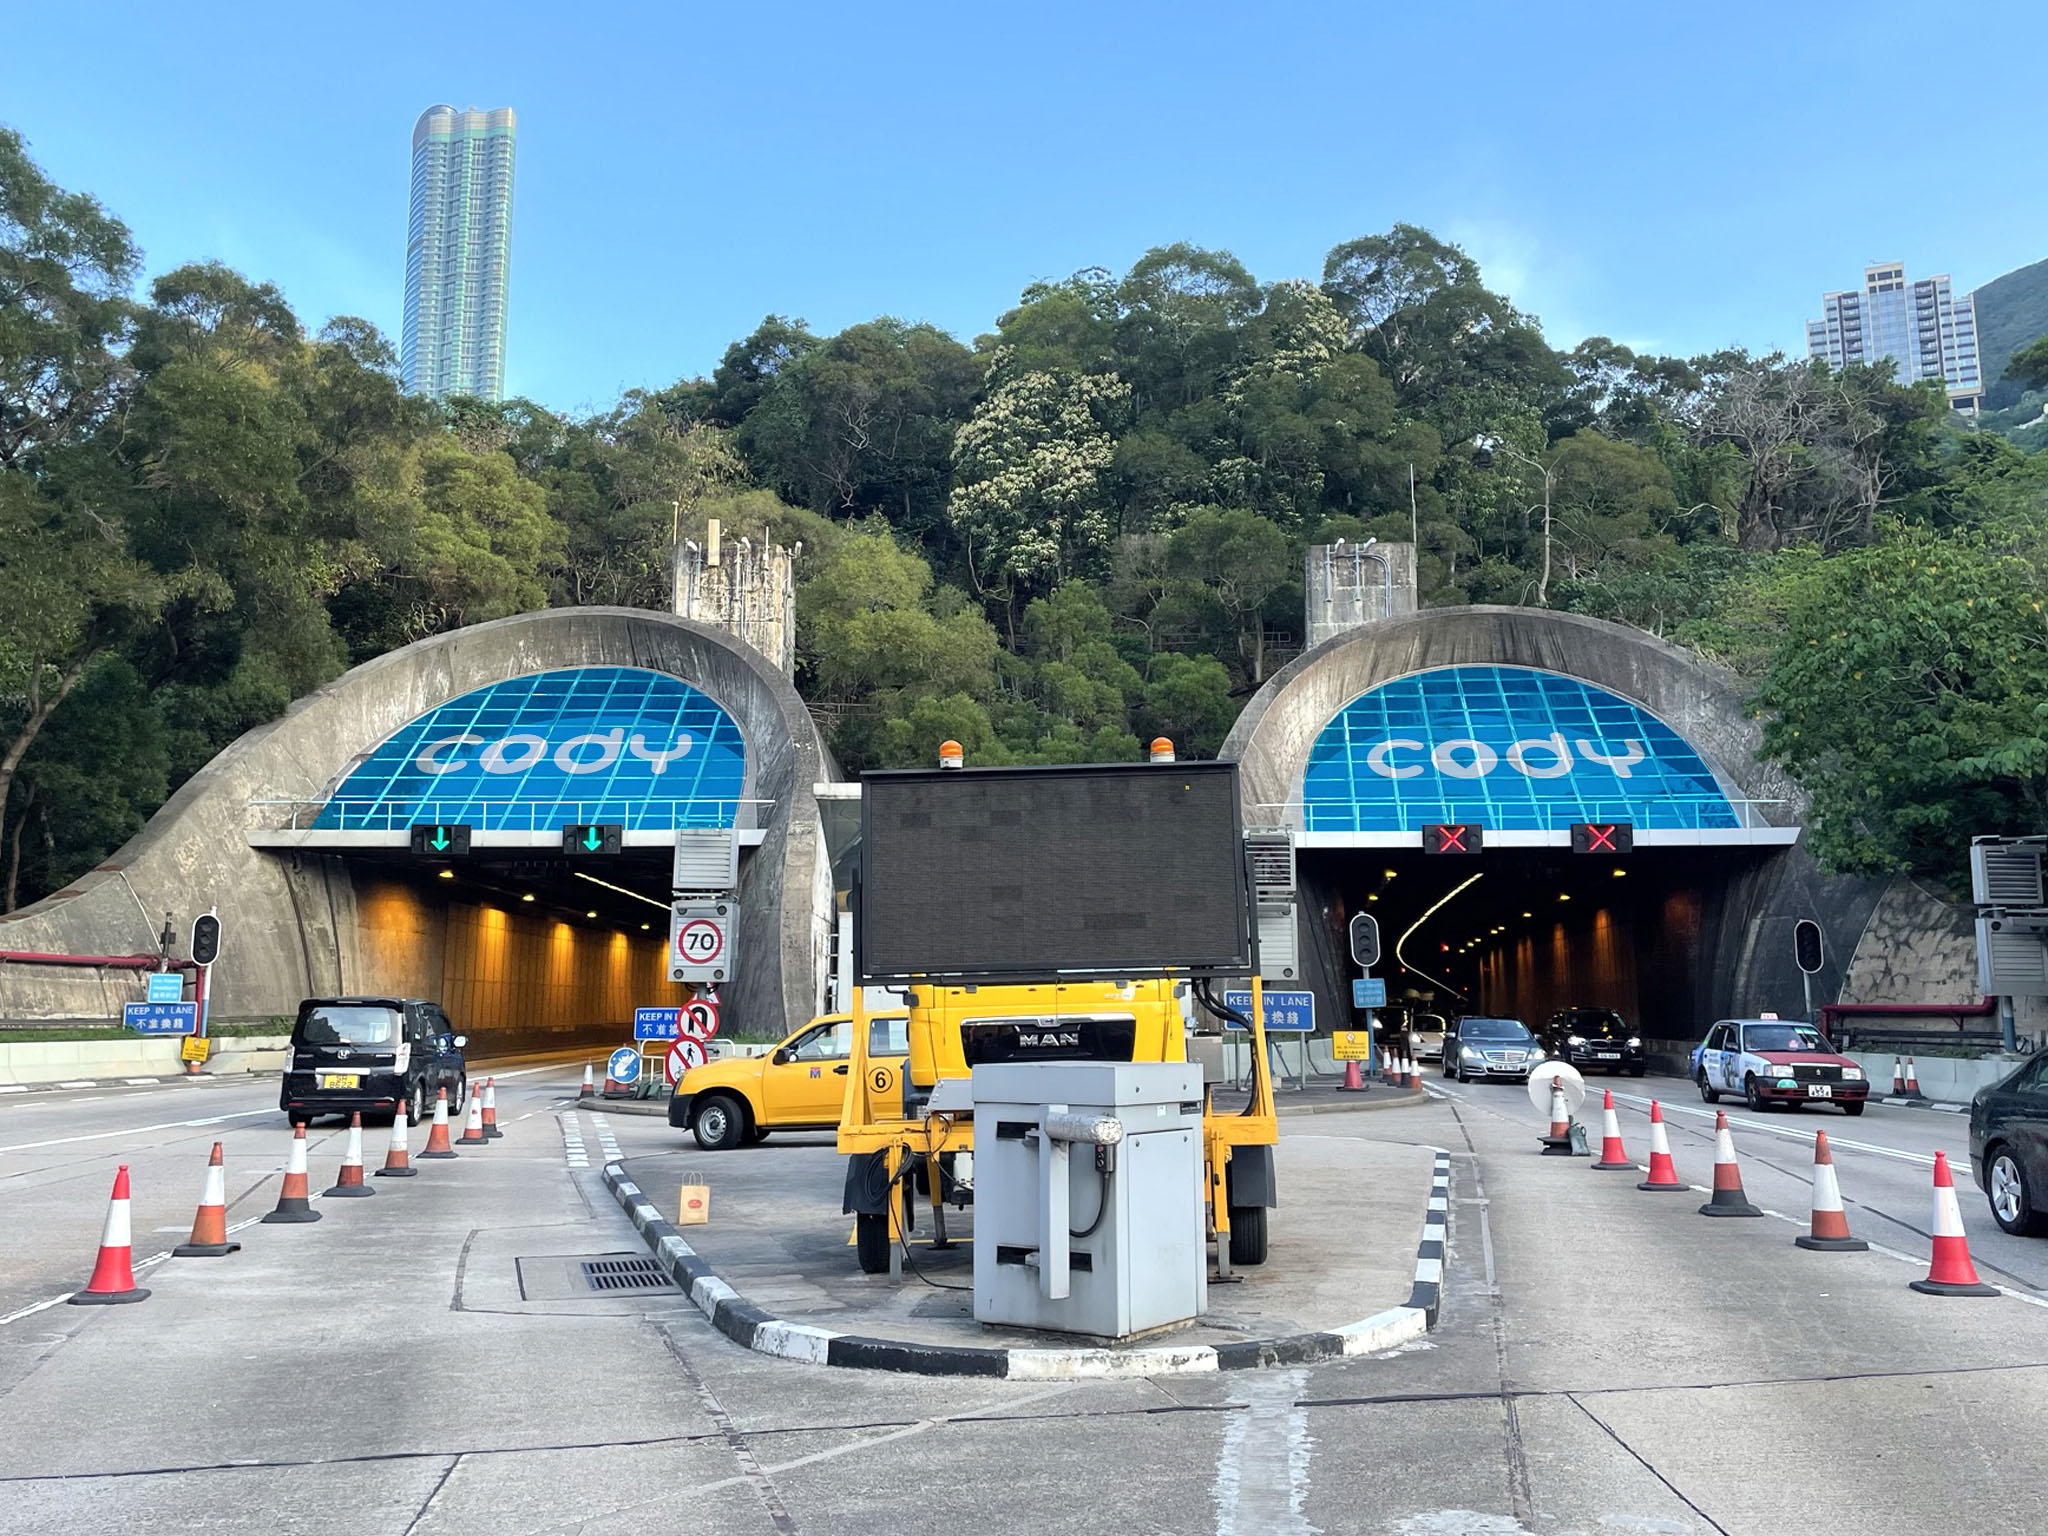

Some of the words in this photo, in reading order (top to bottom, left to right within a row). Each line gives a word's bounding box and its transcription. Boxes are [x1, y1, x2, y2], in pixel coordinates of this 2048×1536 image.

[687, 933, 715, 951] 70
[1264, 997, 1275, 1006] IN
[1280, 996, 1310, 1006] LANE
[127, 1006, 150, 1015] KEEP
[155, 1006, 165, 1015] IN
[170, 1005, 194, 1014] LANE
[639, 1012, 663, 1021] KEEP
[664, 1012, 673, 1021] IN
[1019, 1032, 1079, 1047] MAN
[874, 1071, 887, 1089] 6
